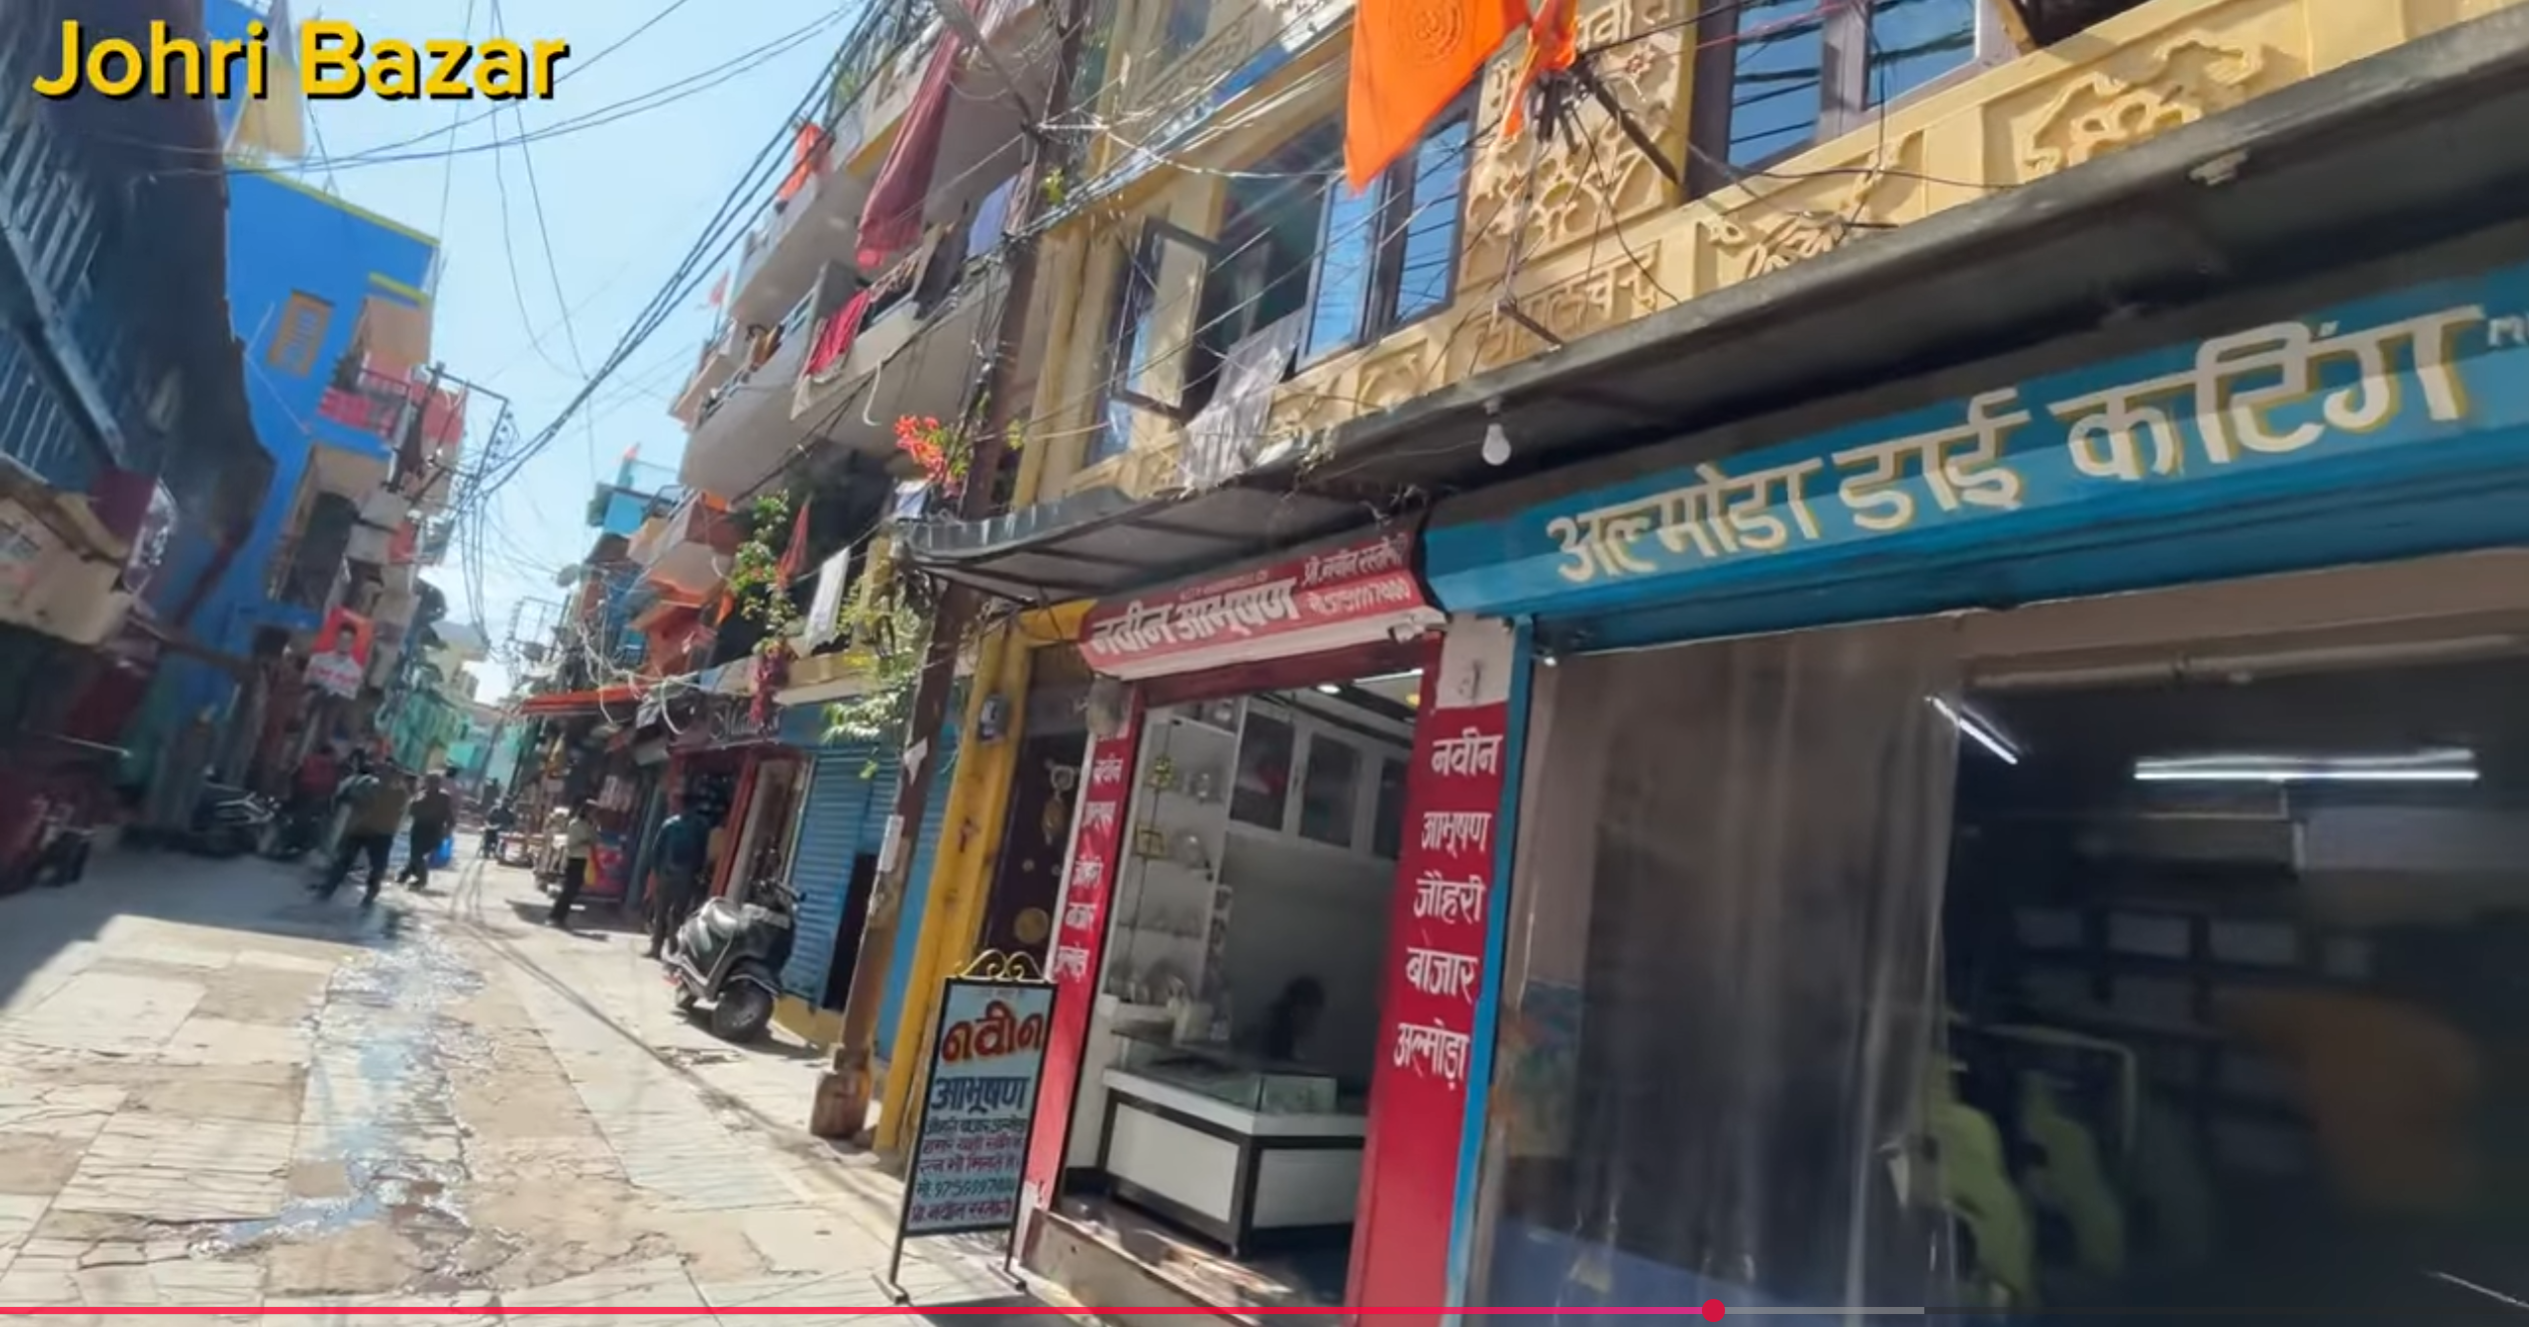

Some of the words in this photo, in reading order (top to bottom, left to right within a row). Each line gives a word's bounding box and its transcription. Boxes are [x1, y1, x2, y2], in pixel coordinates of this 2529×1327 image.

[1832, 389, 2031, 530] डाई
[2047, 305, 2485, 480] कटिंग
[1091, 600, 1177, 655] नवीन
[1175, 577, 1300, 640] आभूषण
[1431, 727, 1504, 777] नवीन
[1421, 811, 1492, 859] आभूषण
[1414, 870, 1486, 925] जौहरी
[1406, 946, 1479, 1004] बाजार
[942, 1000, 1044, 1065] नवीन
[1393, 1018, 1470, 1091] अल्मोड़ा
[930, 1076, 1031, 1114] आभूषण
